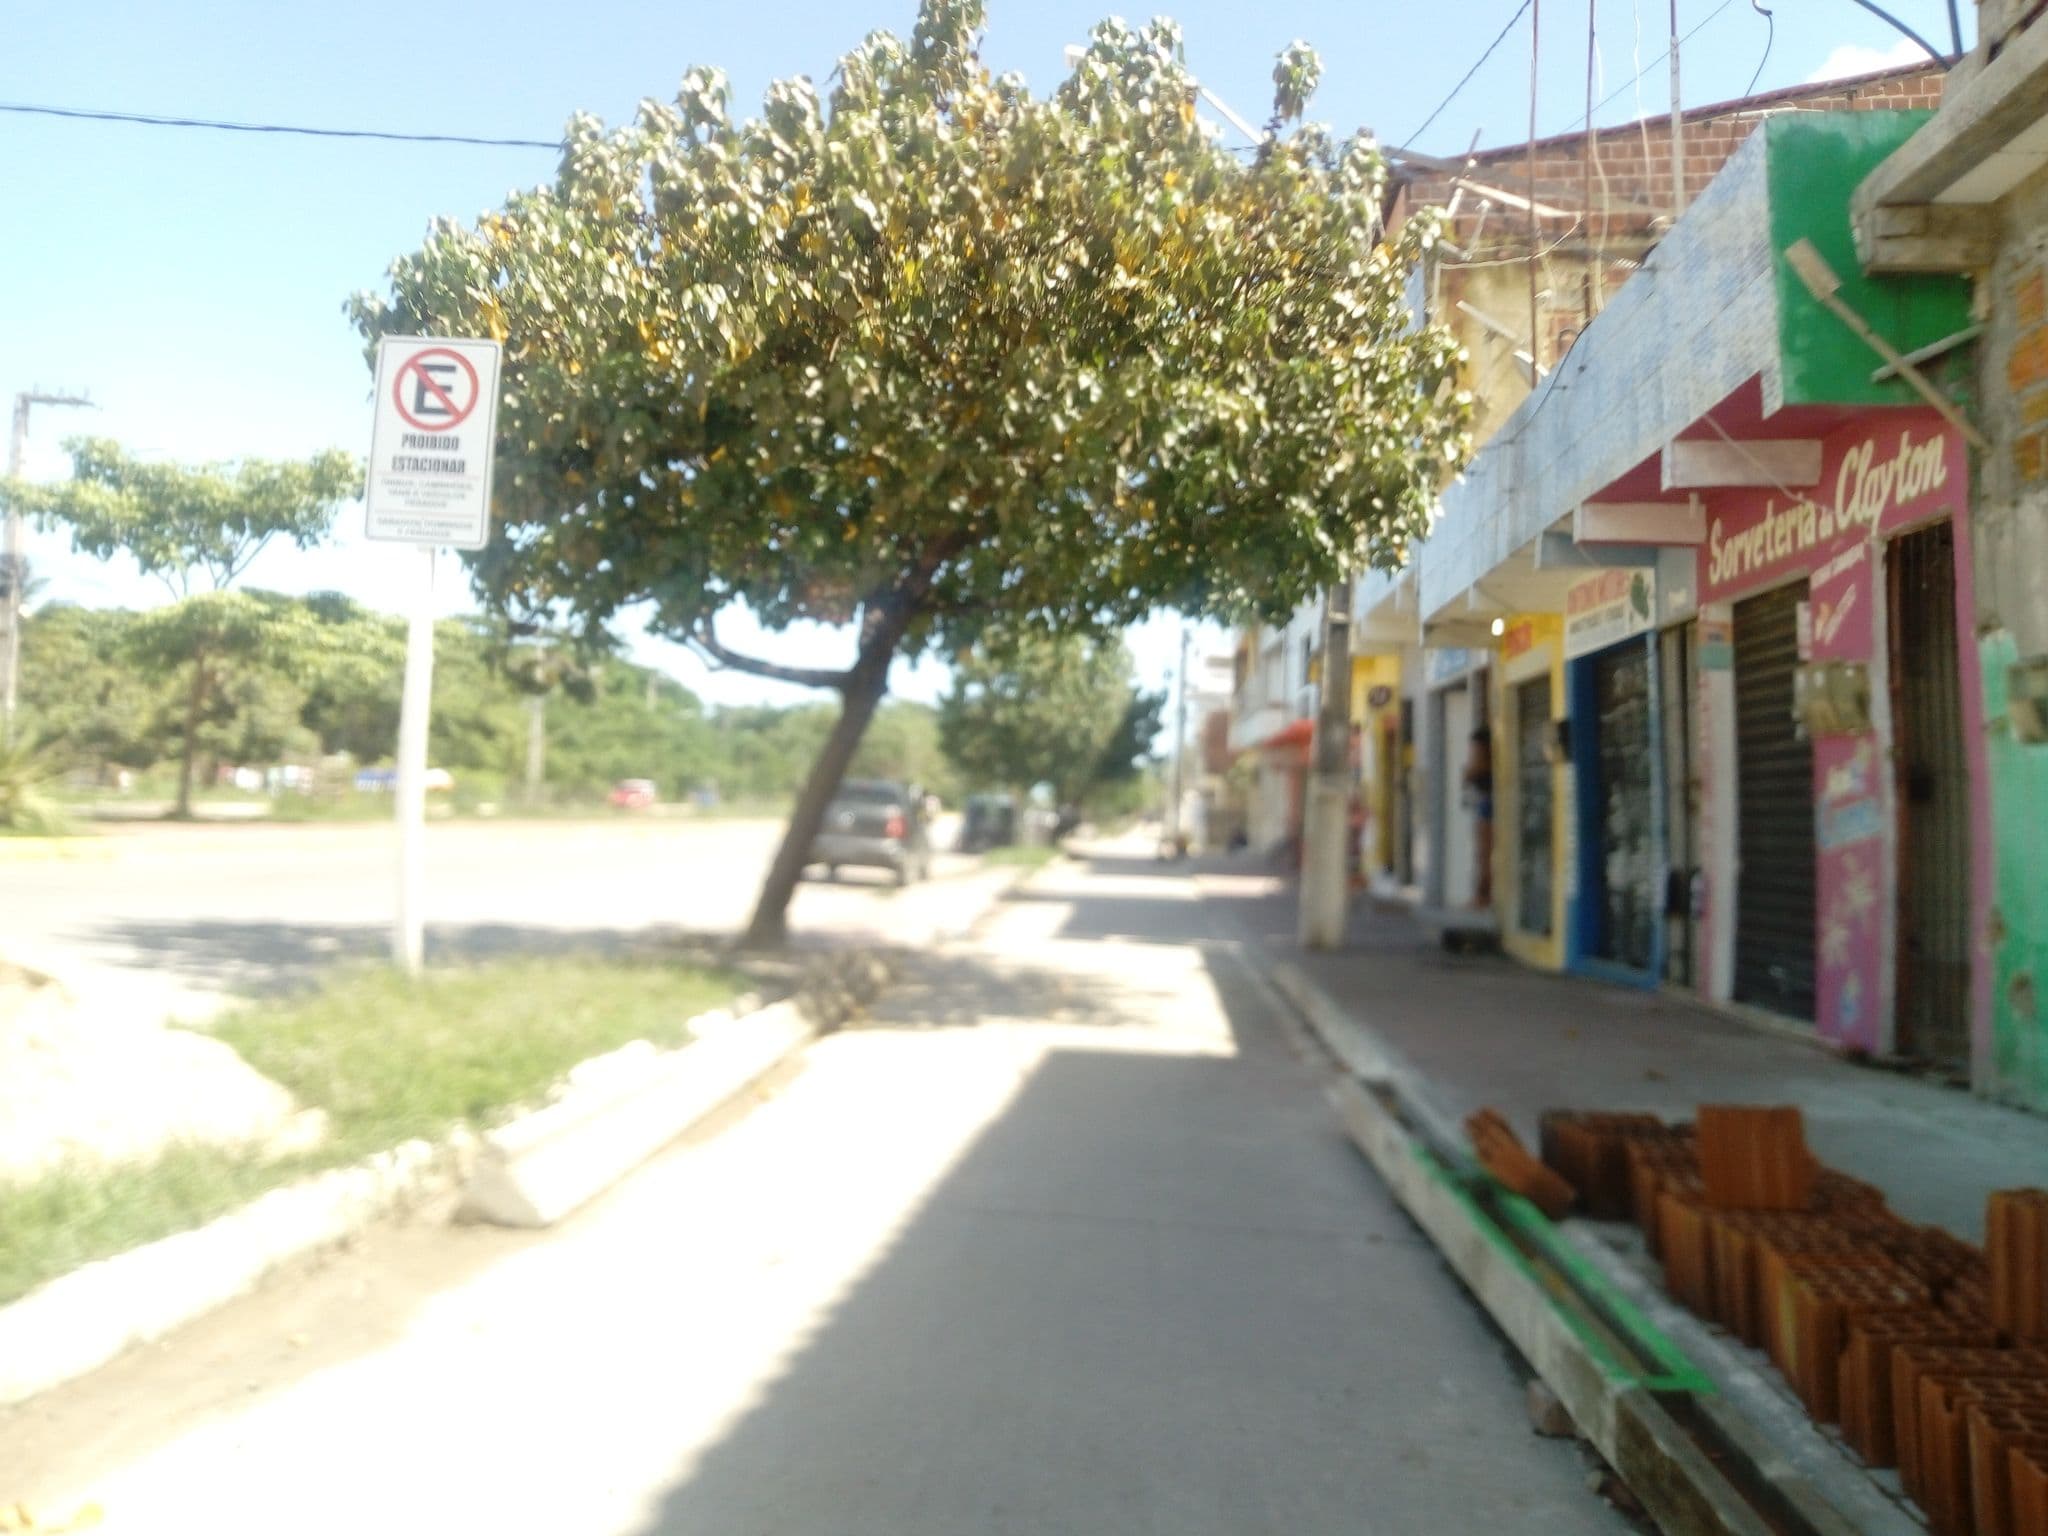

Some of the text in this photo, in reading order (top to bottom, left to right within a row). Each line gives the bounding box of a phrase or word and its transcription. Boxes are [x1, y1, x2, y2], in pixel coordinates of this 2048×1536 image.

[401, 433, 460, 451] PROIBIDO
[391, 455, 466, 473] ESTACIONAR
[1709, 494, 1816, 585] Sorveteria
[1834, 430, 1947, 536] Clayton
